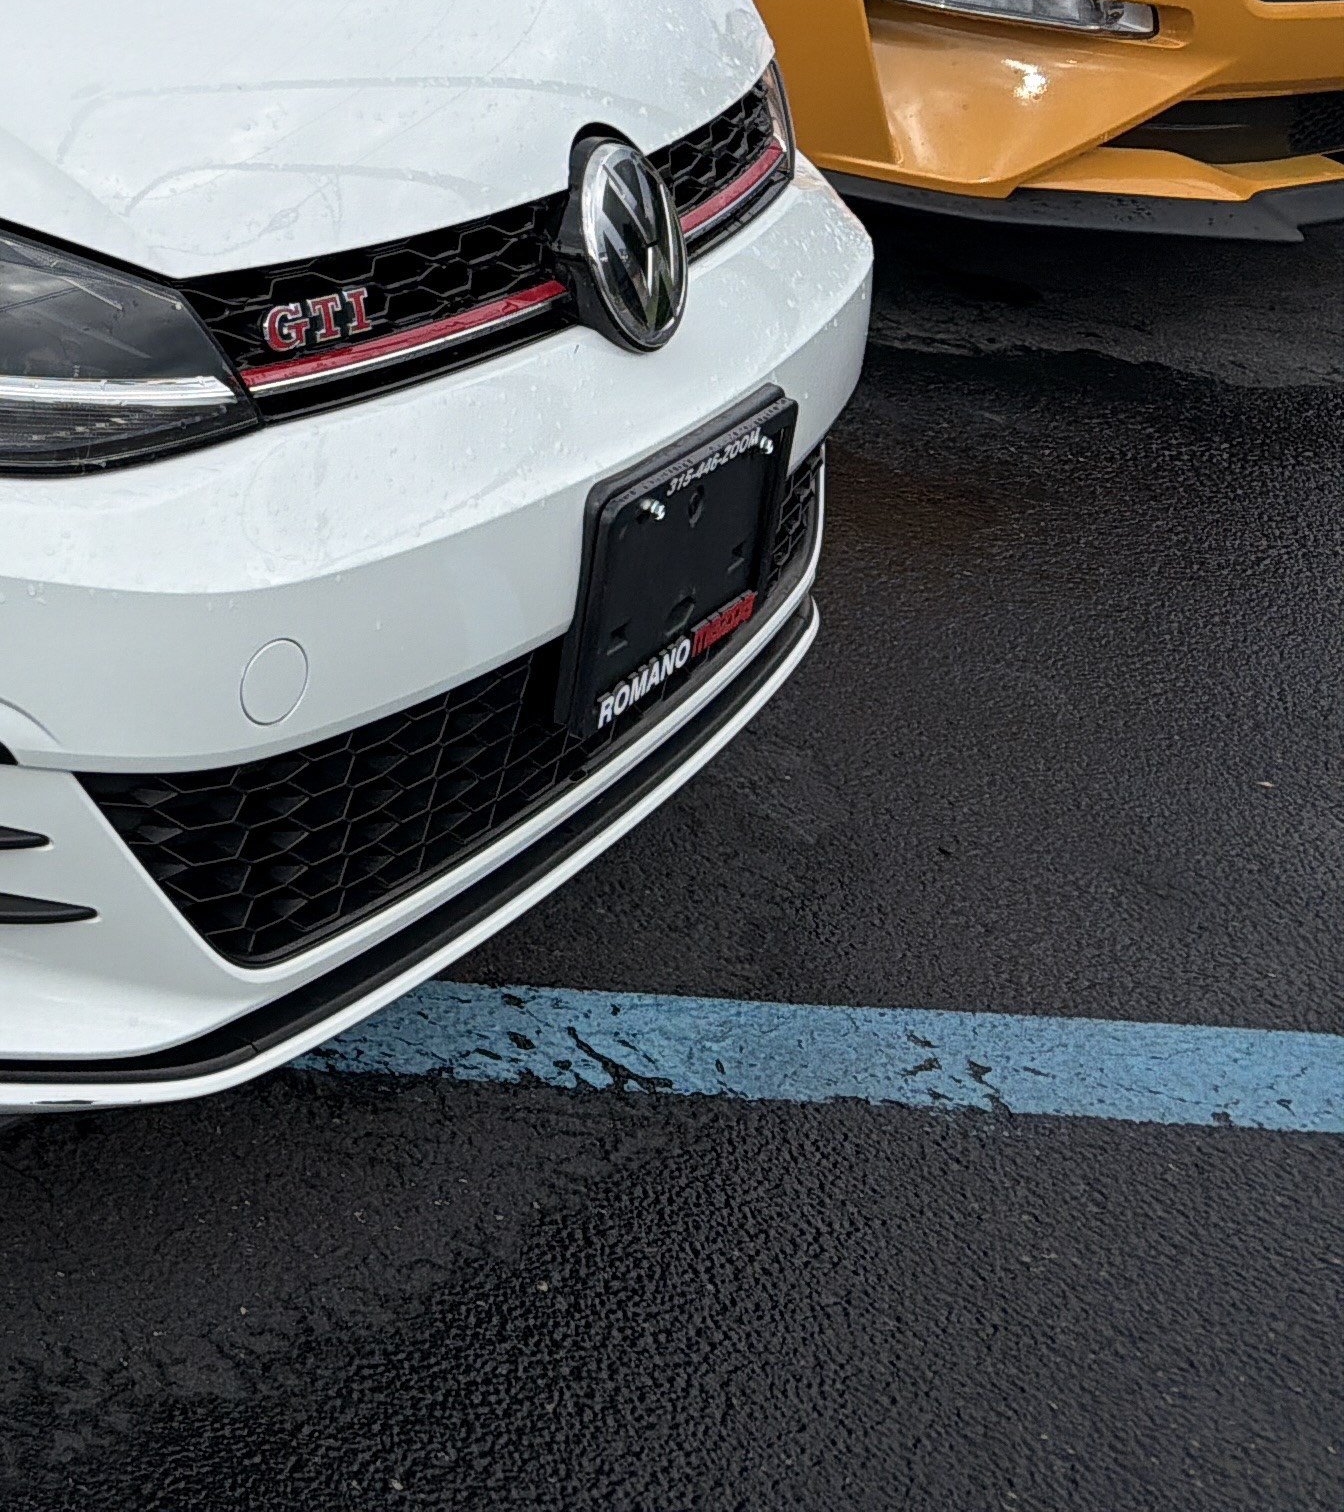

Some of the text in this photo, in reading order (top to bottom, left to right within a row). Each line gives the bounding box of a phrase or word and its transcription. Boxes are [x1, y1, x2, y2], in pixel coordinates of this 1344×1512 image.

[263, 287, 373, 352] GTI
[667, 427, 761, 496] 315-446-ZOOM
[597, 637, 691, 729] ROMANO
